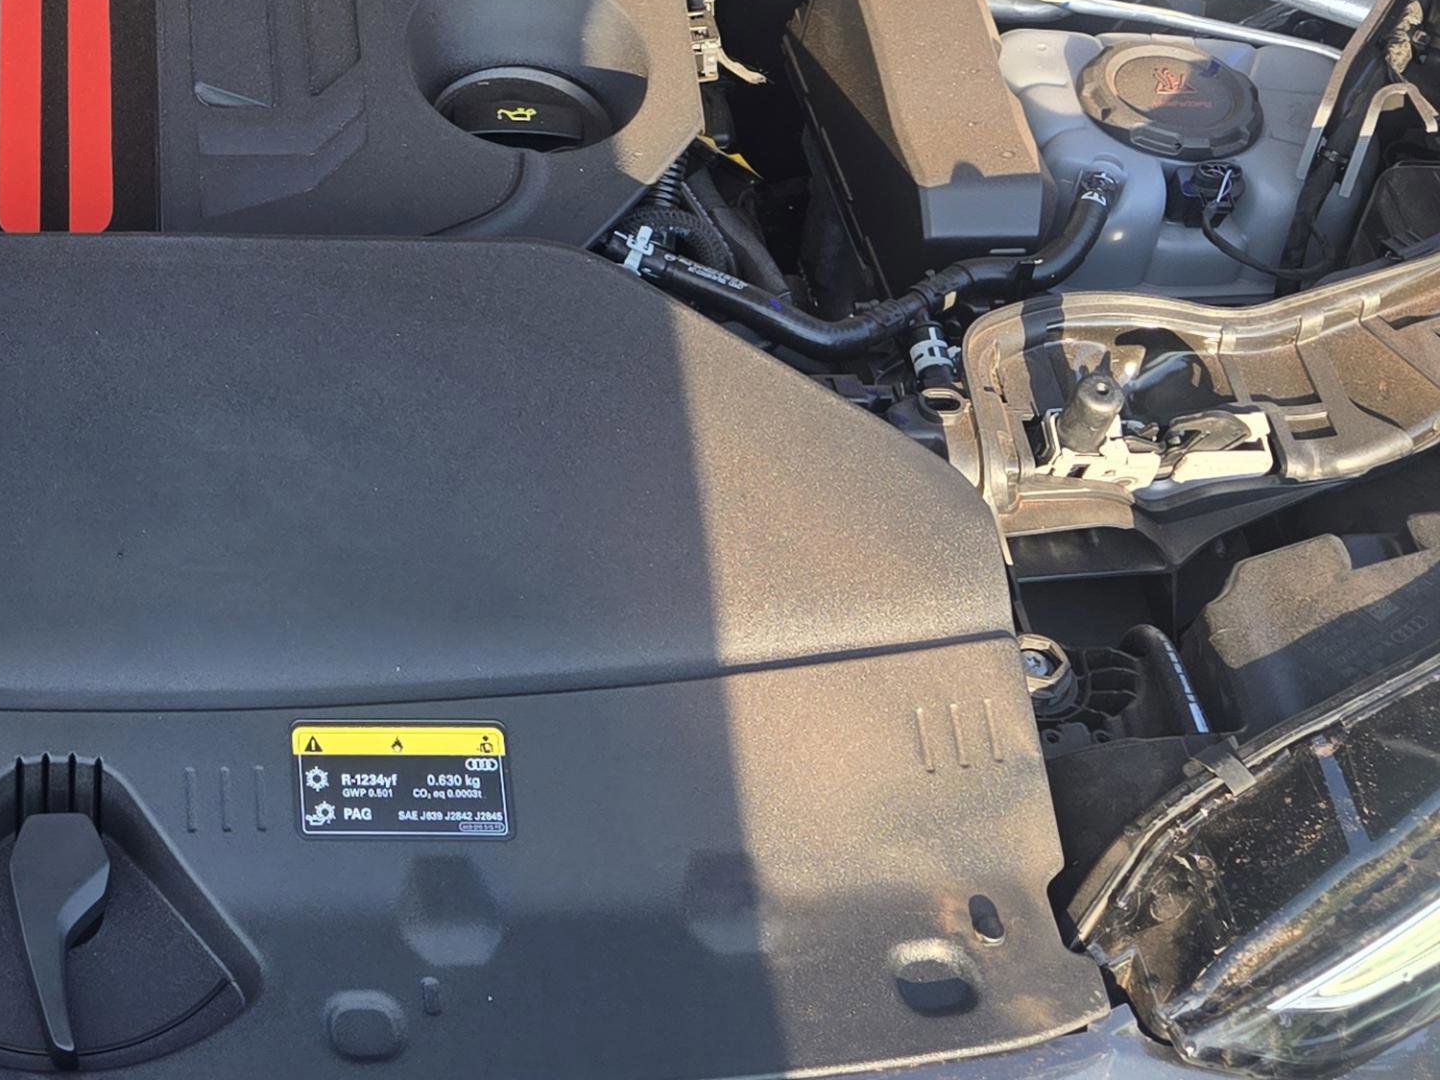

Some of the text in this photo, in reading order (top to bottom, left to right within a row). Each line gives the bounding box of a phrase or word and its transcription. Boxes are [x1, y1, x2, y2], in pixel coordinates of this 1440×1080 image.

[341, 774, 398, 788] R-1234yf
[427, 774, 481, 788] 0.630 kg
[342, 788, 393, 798] GWP 0.501
[343, 808, 372, 820] PAG
[398, 811, 418, 820] SAE
